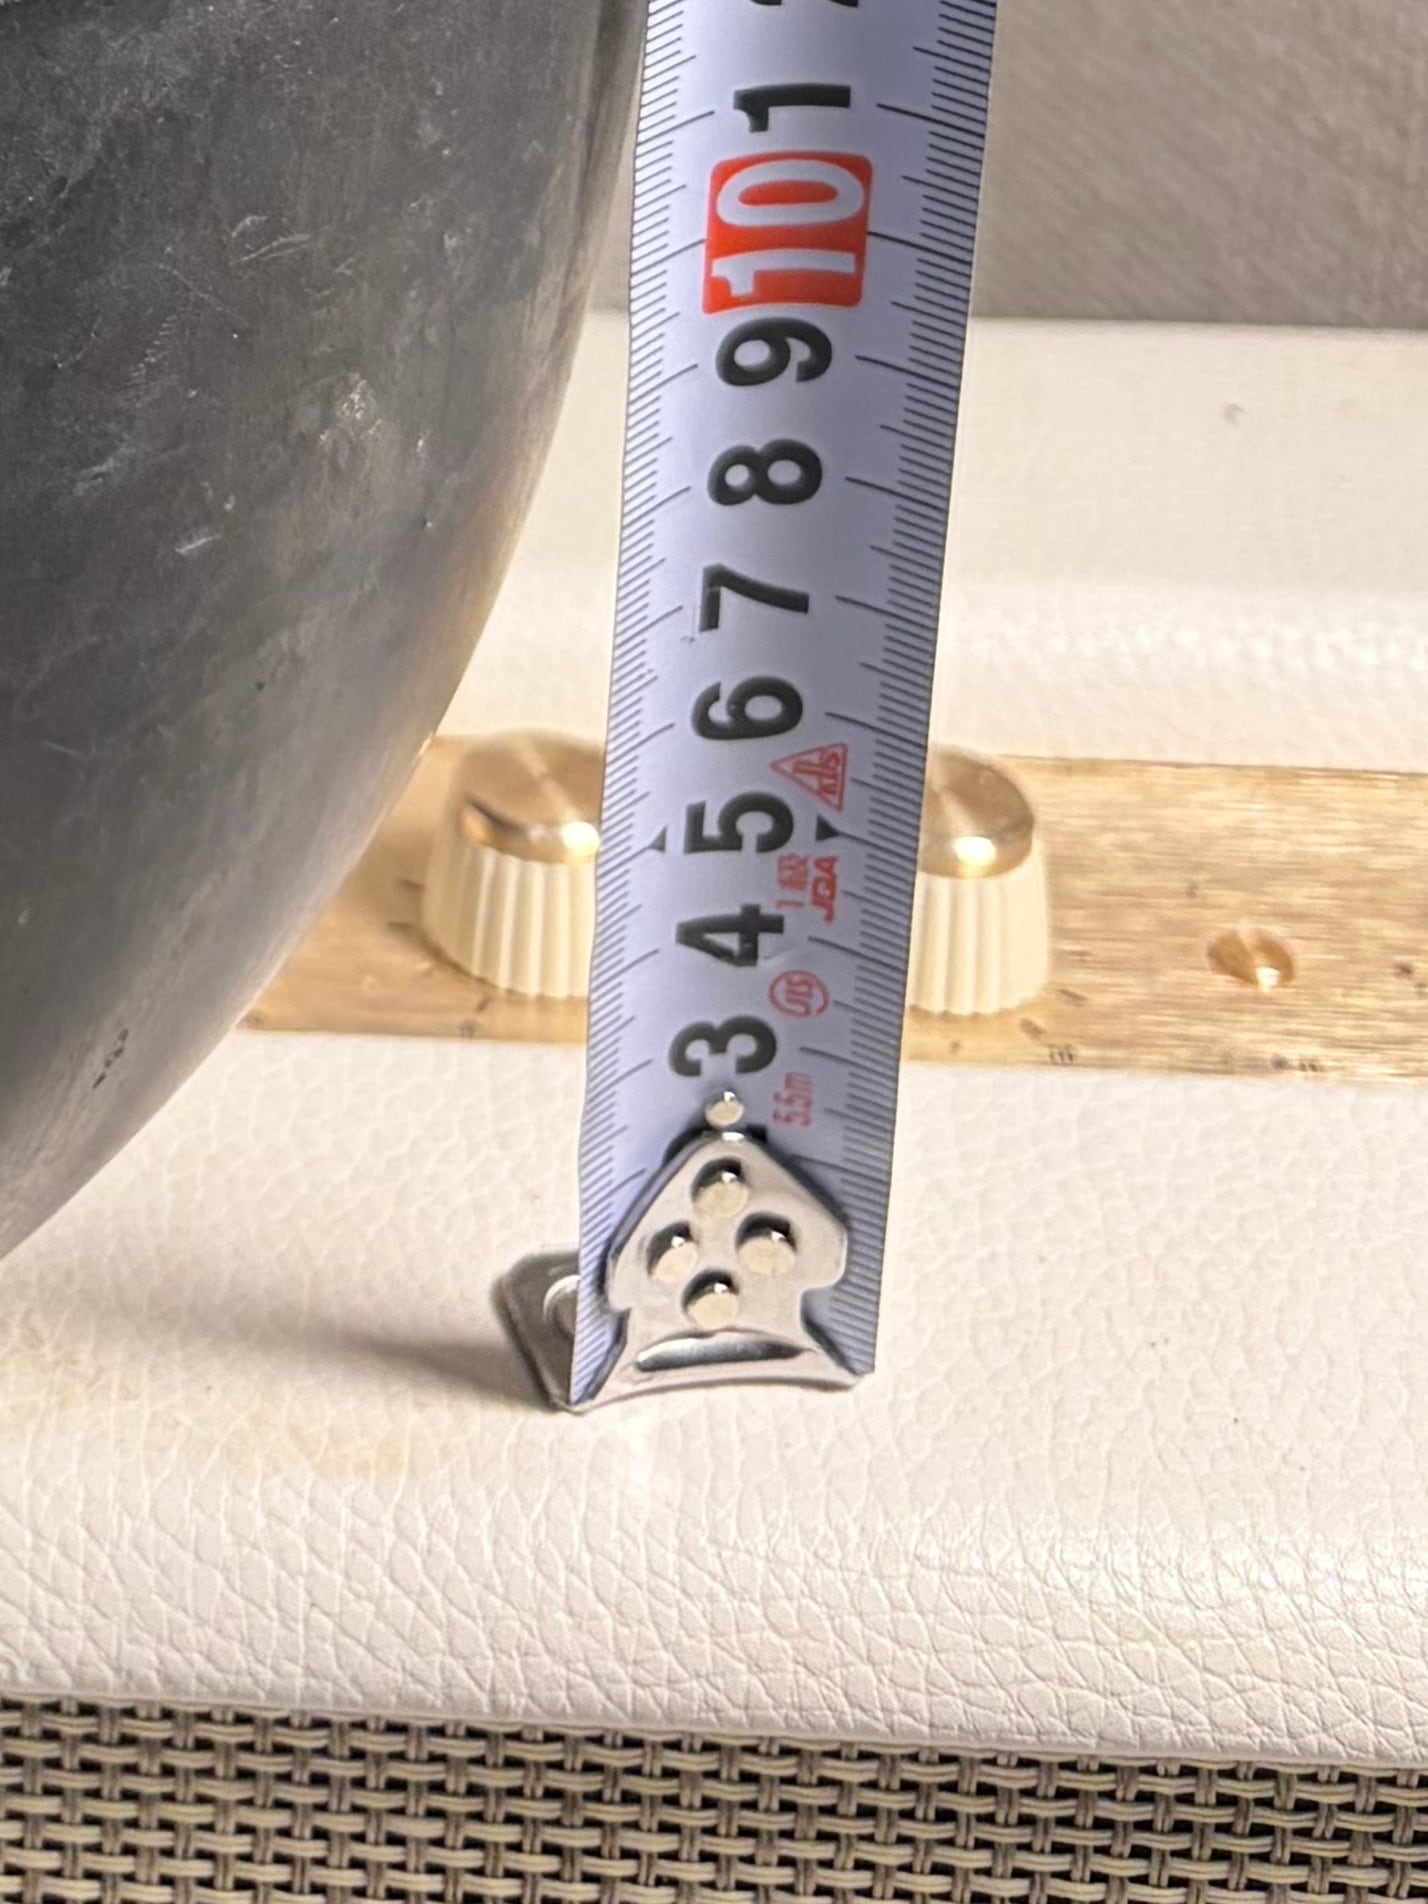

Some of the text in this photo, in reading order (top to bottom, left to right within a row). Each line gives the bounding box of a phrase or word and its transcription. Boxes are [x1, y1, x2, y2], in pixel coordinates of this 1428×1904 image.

[733, 83, 852, 133] 1
[711, 158, 865, 299] 10
[715, 317, 833, 387] 9
[707, 438, 823, 506] 8
[698, 563, 810, 633] 7
[691, 675, 803, 741] 6
[684, 791, 794, 855] 5
[675, 903, 784, 966] 4
[668, 1014, 778, 1078] 3
